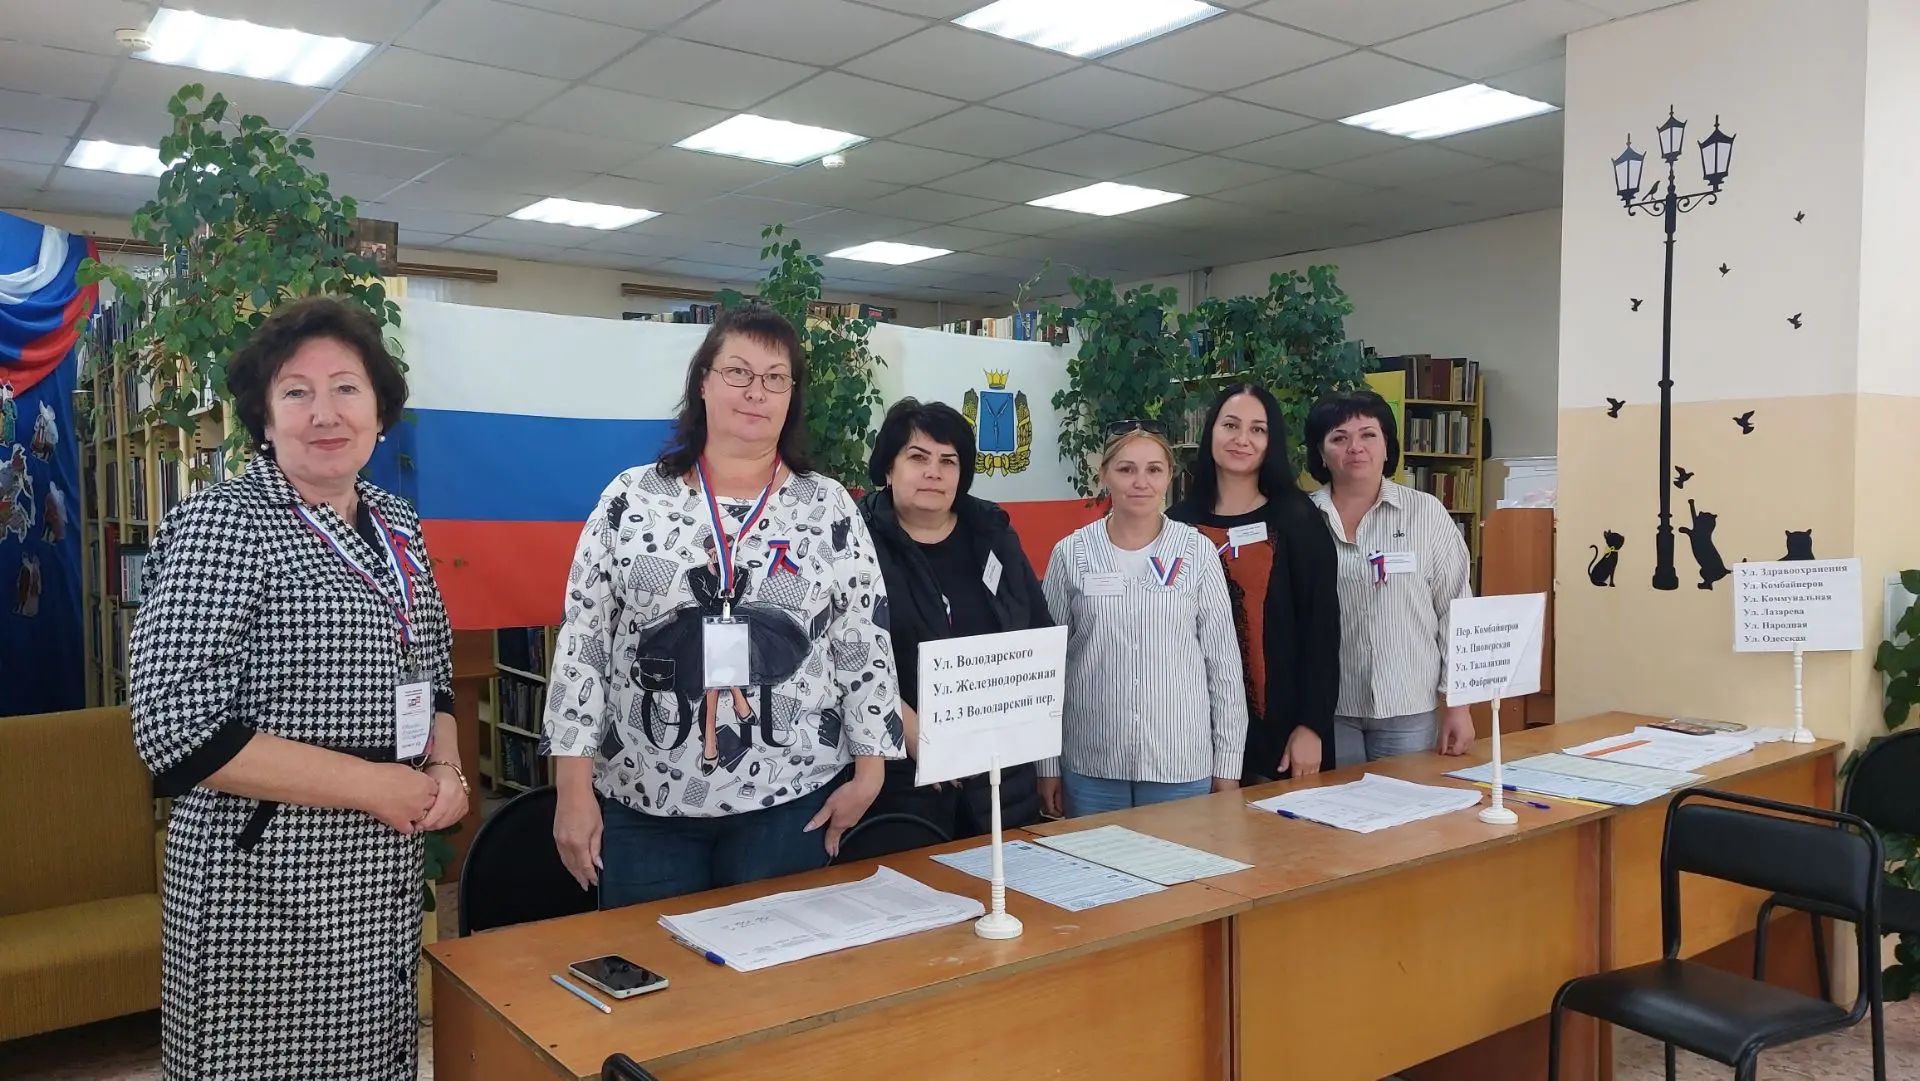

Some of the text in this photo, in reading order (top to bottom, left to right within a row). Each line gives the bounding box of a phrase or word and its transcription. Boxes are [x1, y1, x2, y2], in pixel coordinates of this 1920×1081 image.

[1741, 565, 1848, 577] Ул. Здравоохранения
[1743, 580, 1824, 590] Ул. Комбайнеров
[1743, 594, 1832, 603] Ул. Коммунальная
[1743, 607, 1804, 617] Ул. Лазарева
[1456, 623, 1519, 638] Пер. Комбайнеров
[1744, 621, 1808, 631] Ул. Народная
[1744, 635, 1806, 643] Ул. Одесская
[1455, 641, 1511, 655] Ул. Пионерская
[933, 648, 1033, 671] Ул. Володарского
[1455, 662, 1468, 672] Ул.
[933, 668, 1056, 696] Ул. Железнодорожная
[1469, 675, 1508, 688] Фабричная
[957, 707, 963, 720] 3
[967, 695, 1033, 718] Володарский
[1036, 693, 1056, 706] пер.
